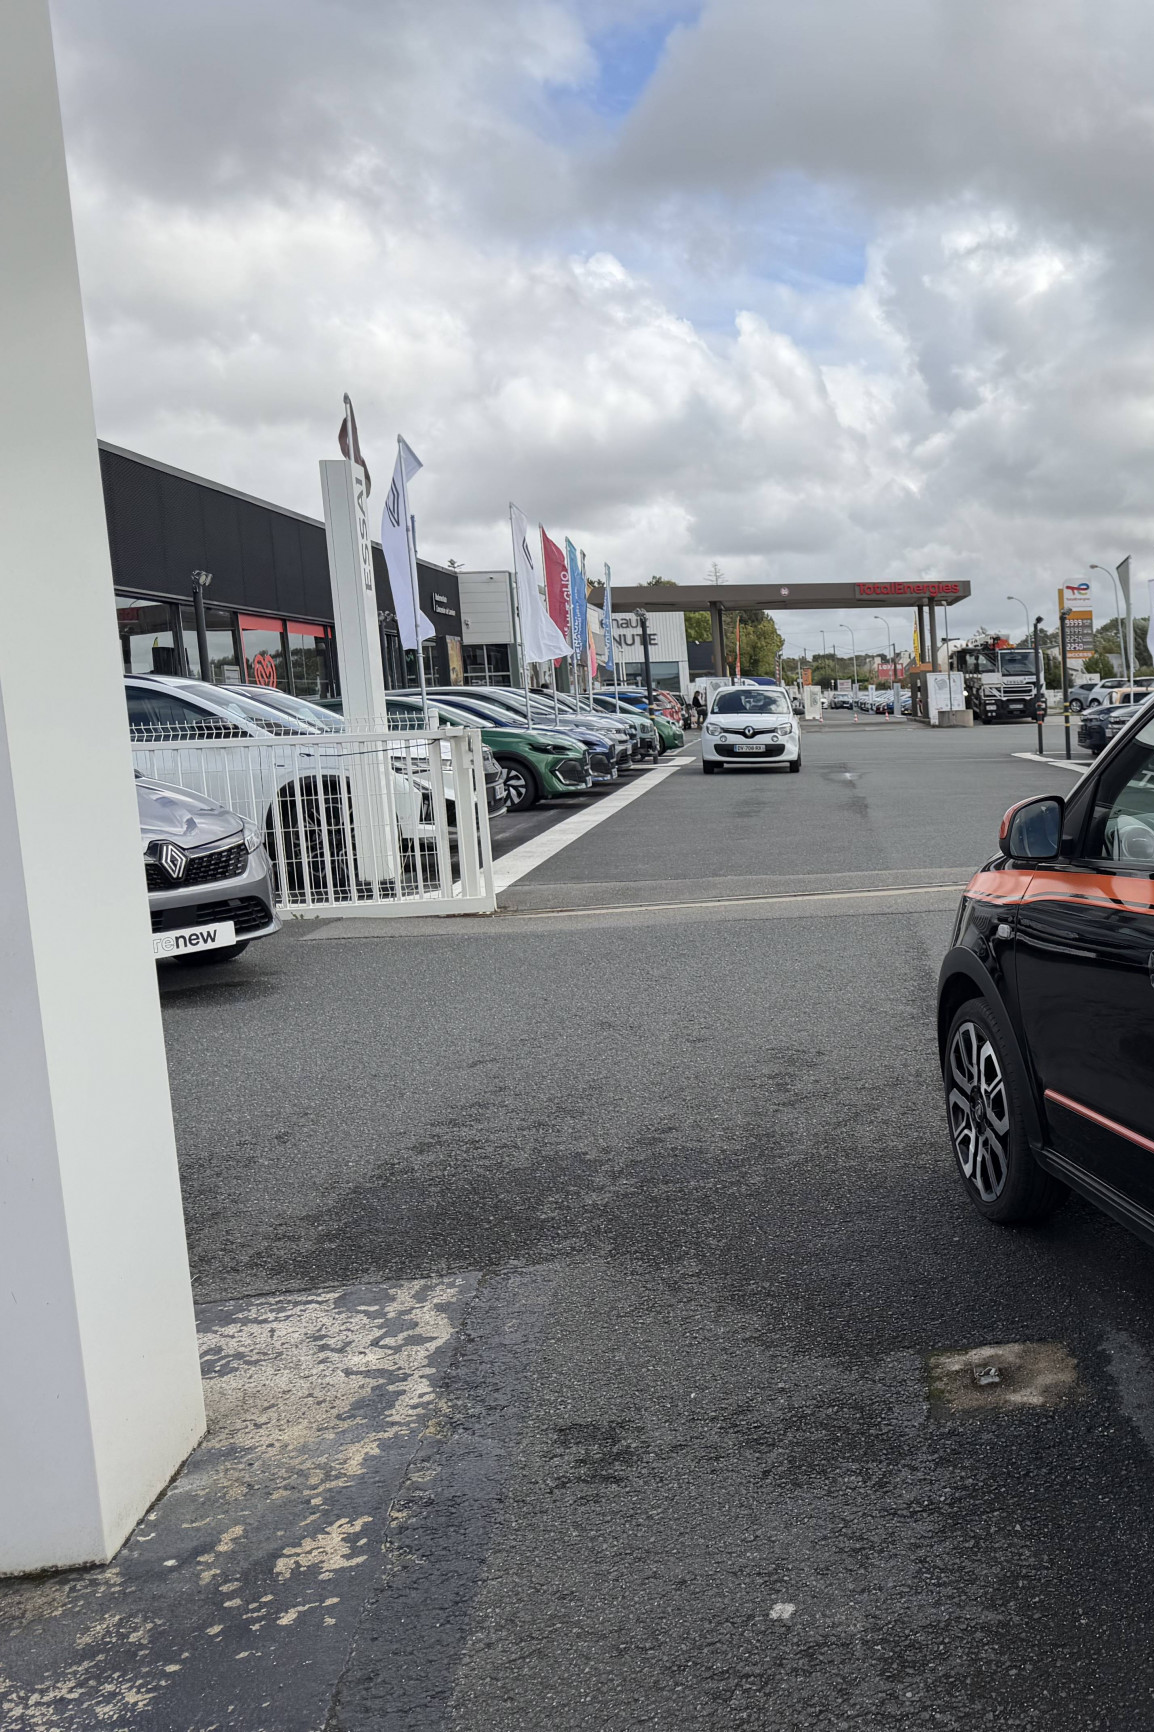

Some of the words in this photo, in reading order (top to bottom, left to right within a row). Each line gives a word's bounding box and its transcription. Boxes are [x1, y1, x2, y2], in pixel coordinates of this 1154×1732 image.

[355, 476, 373, 592] ESSAI
[856, 582, 960, 597] TotalEnergies
[152, 929, 218, 954] renew
